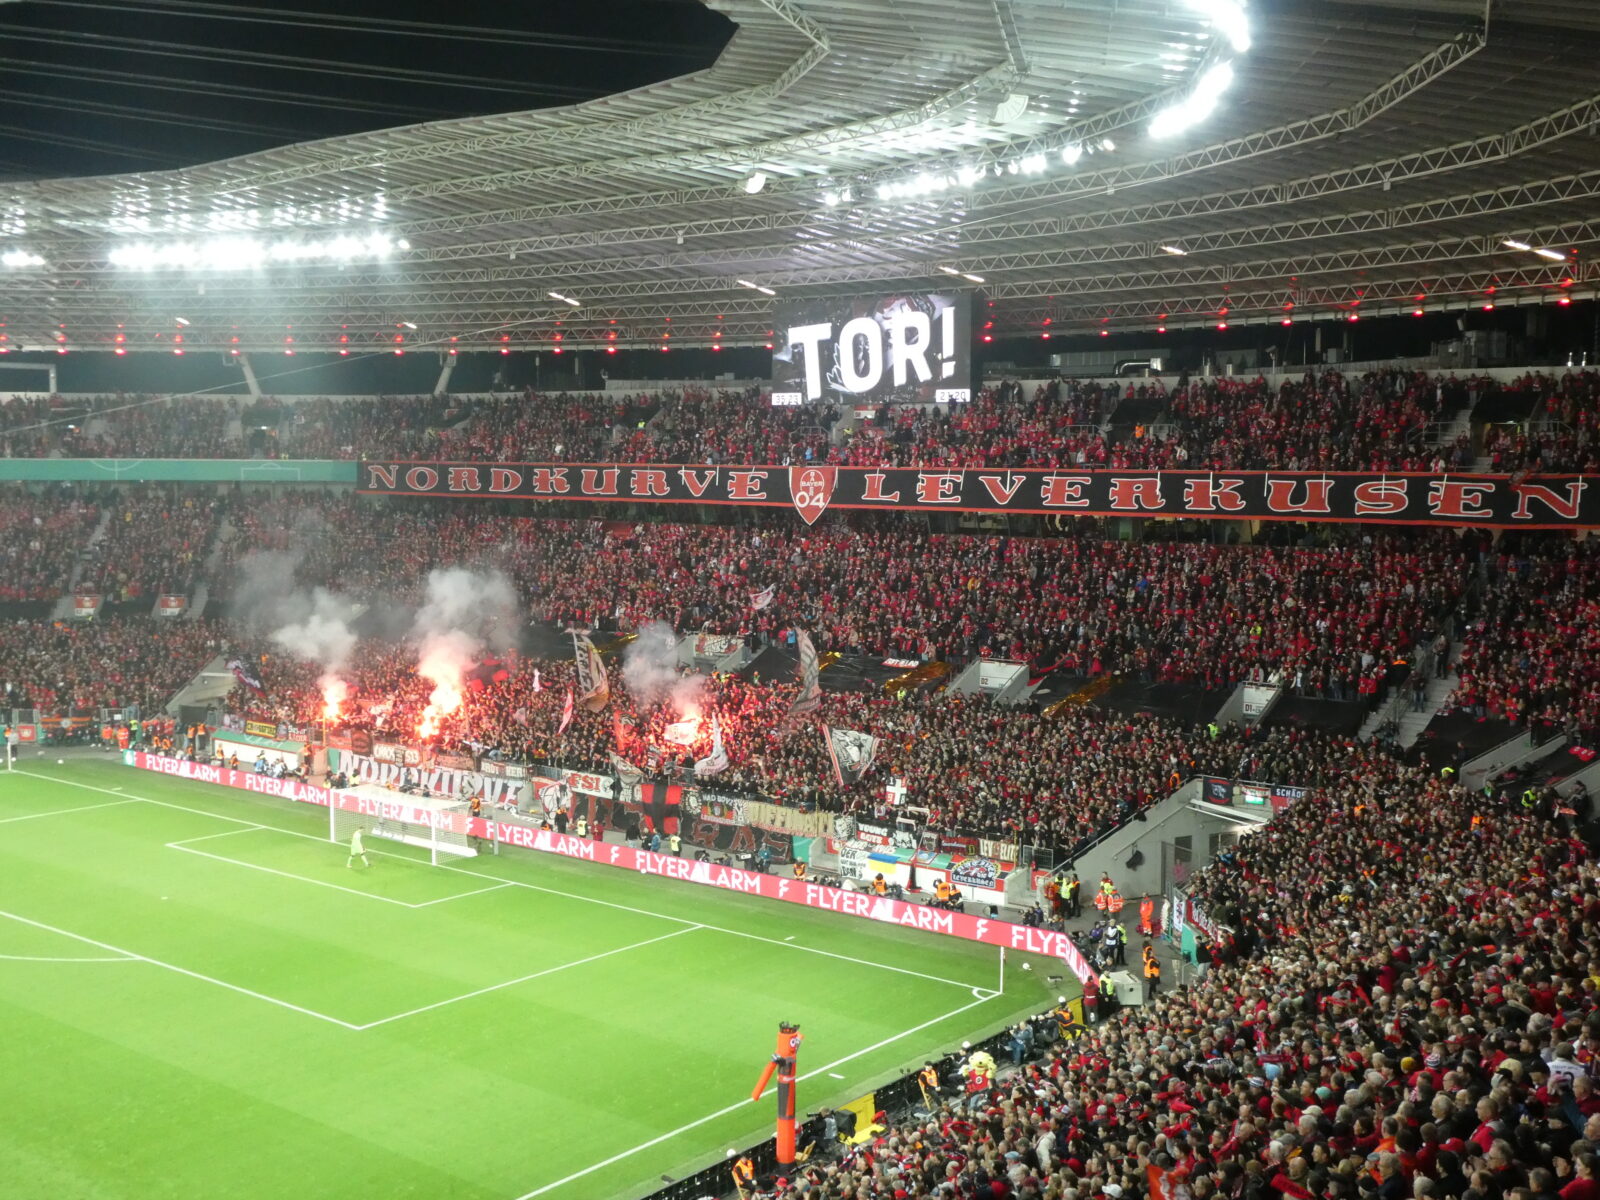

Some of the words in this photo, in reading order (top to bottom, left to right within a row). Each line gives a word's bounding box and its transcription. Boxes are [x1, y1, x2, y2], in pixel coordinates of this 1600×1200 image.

[788, 306, 956, 401] TOR!
[368, 465, 768, 500] NORDKURVE
[795, 491, 826, 509] 04
[861, 473, 1588, 519] LEVERKUSEN
[146, 754, 220, 784] FLYERALARM
[245, 776, 327, 806] FLYERALARM
[486, 821, 594, 860] FLYERALARM
[635, 850, 761, 894] FLYERALARM
[806, 885, 953, 934] FLYERALARM
